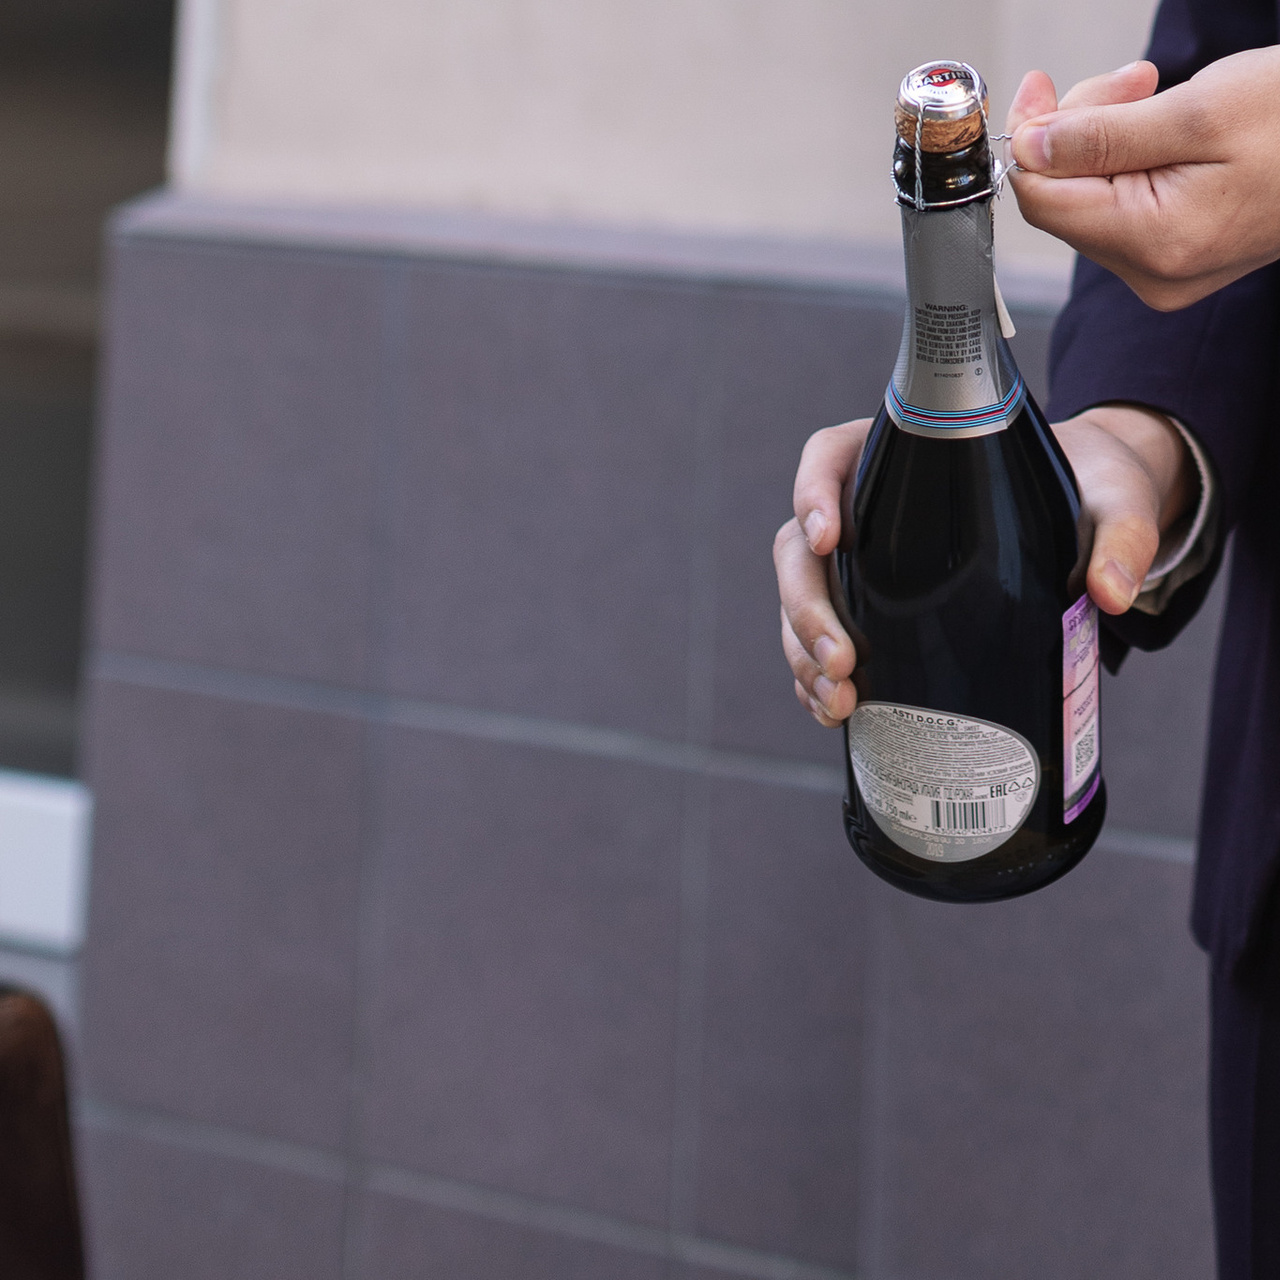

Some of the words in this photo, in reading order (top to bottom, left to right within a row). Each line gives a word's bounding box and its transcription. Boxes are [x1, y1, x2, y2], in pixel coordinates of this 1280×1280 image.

[925, 303, 968, 312] WARNING:
[940, 357, 964, 365] CORKSCREW
[893, 708, 914, 720] ASTI
